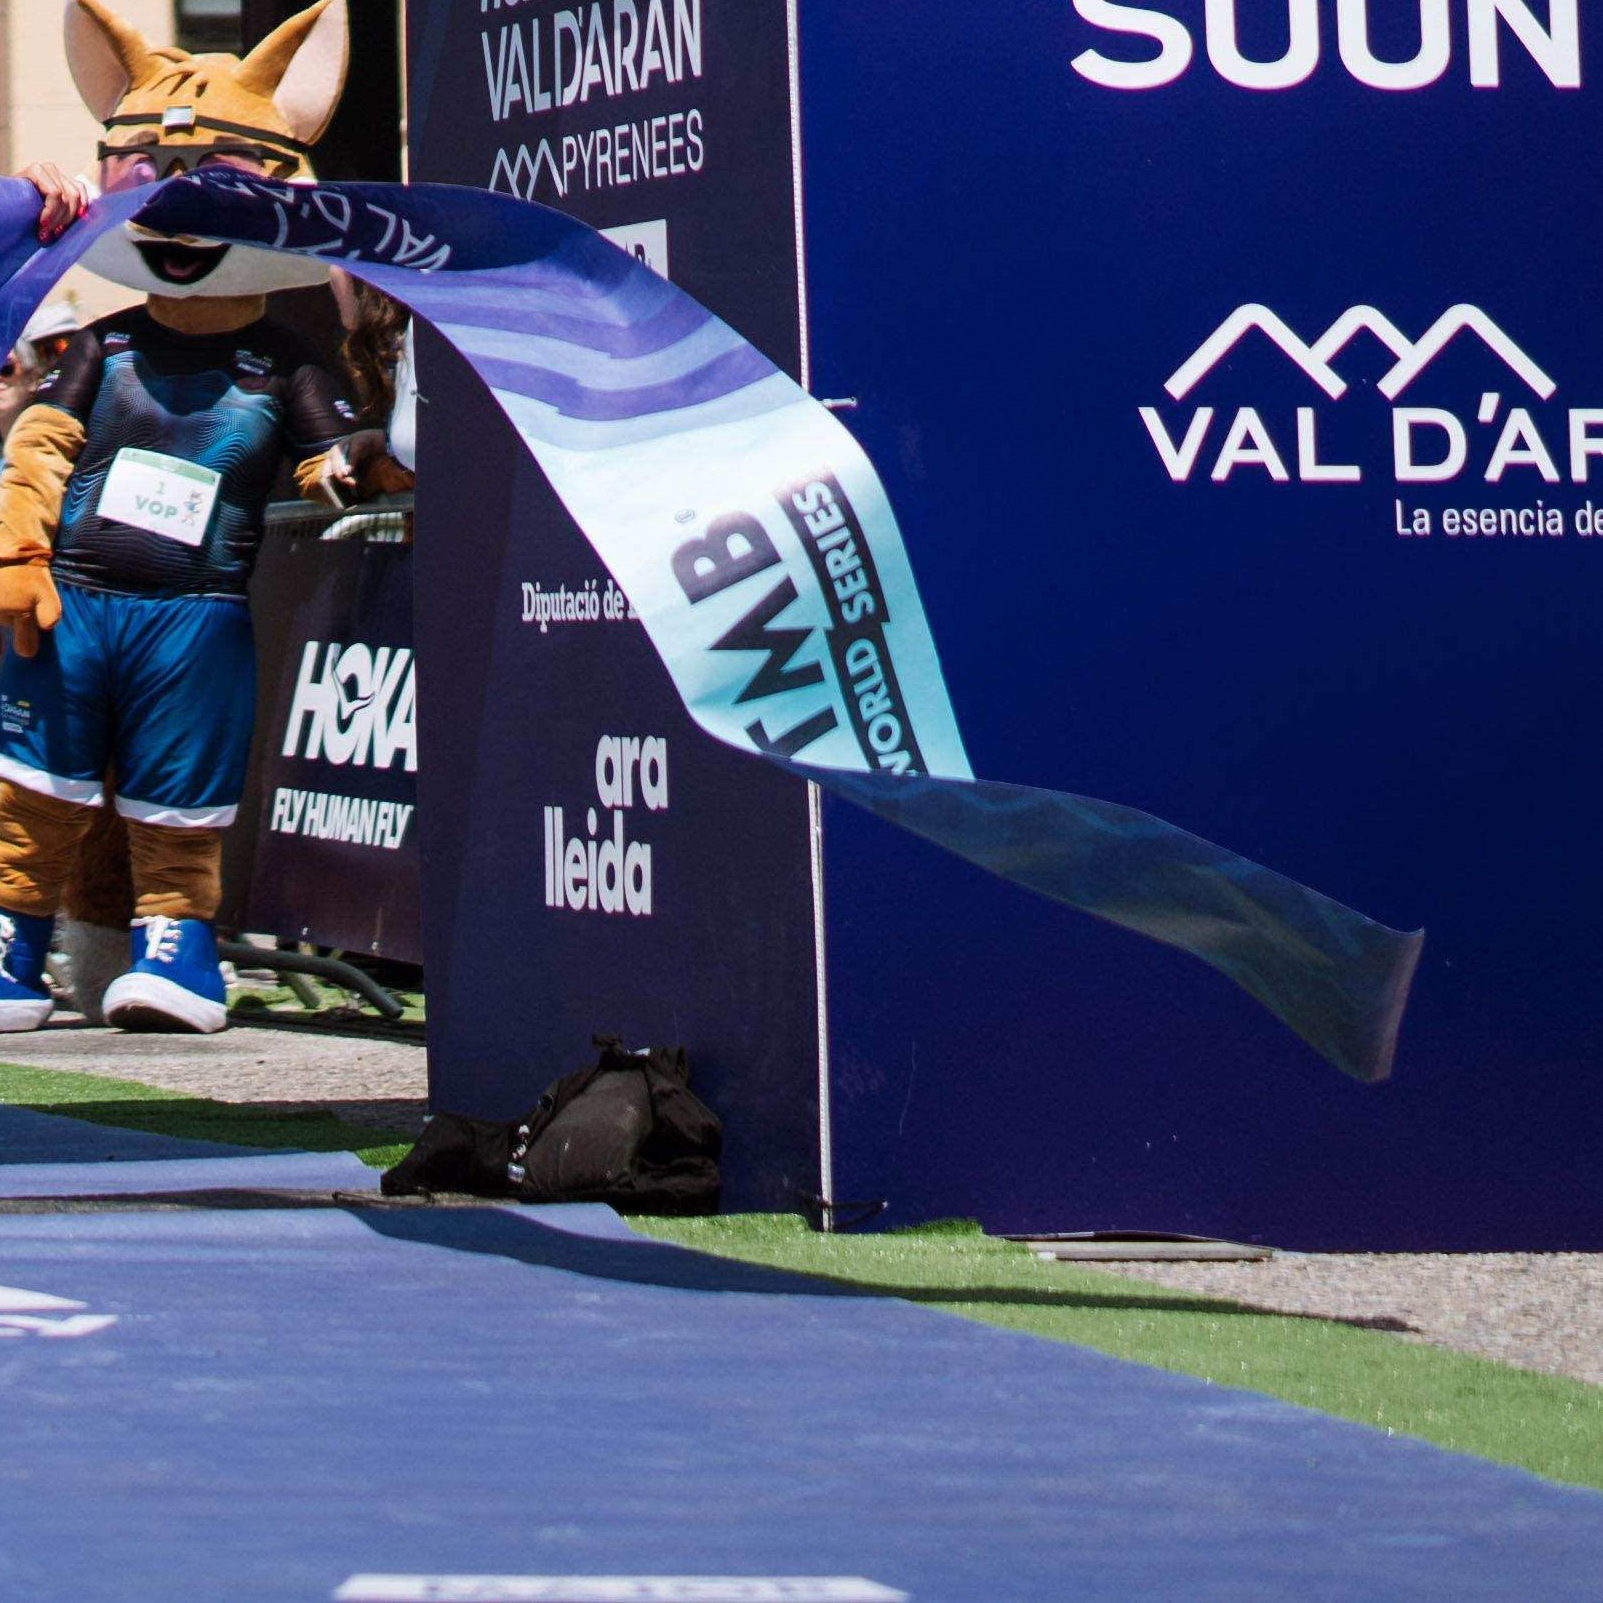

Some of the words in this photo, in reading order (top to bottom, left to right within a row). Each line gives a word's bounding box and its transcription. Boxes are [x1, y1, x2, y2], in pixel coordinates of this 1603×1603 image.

[563, 108, 704, 195] PYRENEES
[1138, 406, 1362, 483] VAL
[791, 479, 878, 626] SERIES
[1396, 499, 1431, 536] La
[1442, 499, 1564, 537] esencia
[521, 579, 600, 634] Diputació
[603, 578, 625, 621] de
[282, 640, 418, 772] HOKA
[595, 734, 668, 809] ara
[270, 787, 307, 834] FLY
[302, 791, 378, 847] HUMAN
[374, 801, 413, 849] FLY
[543, 805, 653, 915] lleida
